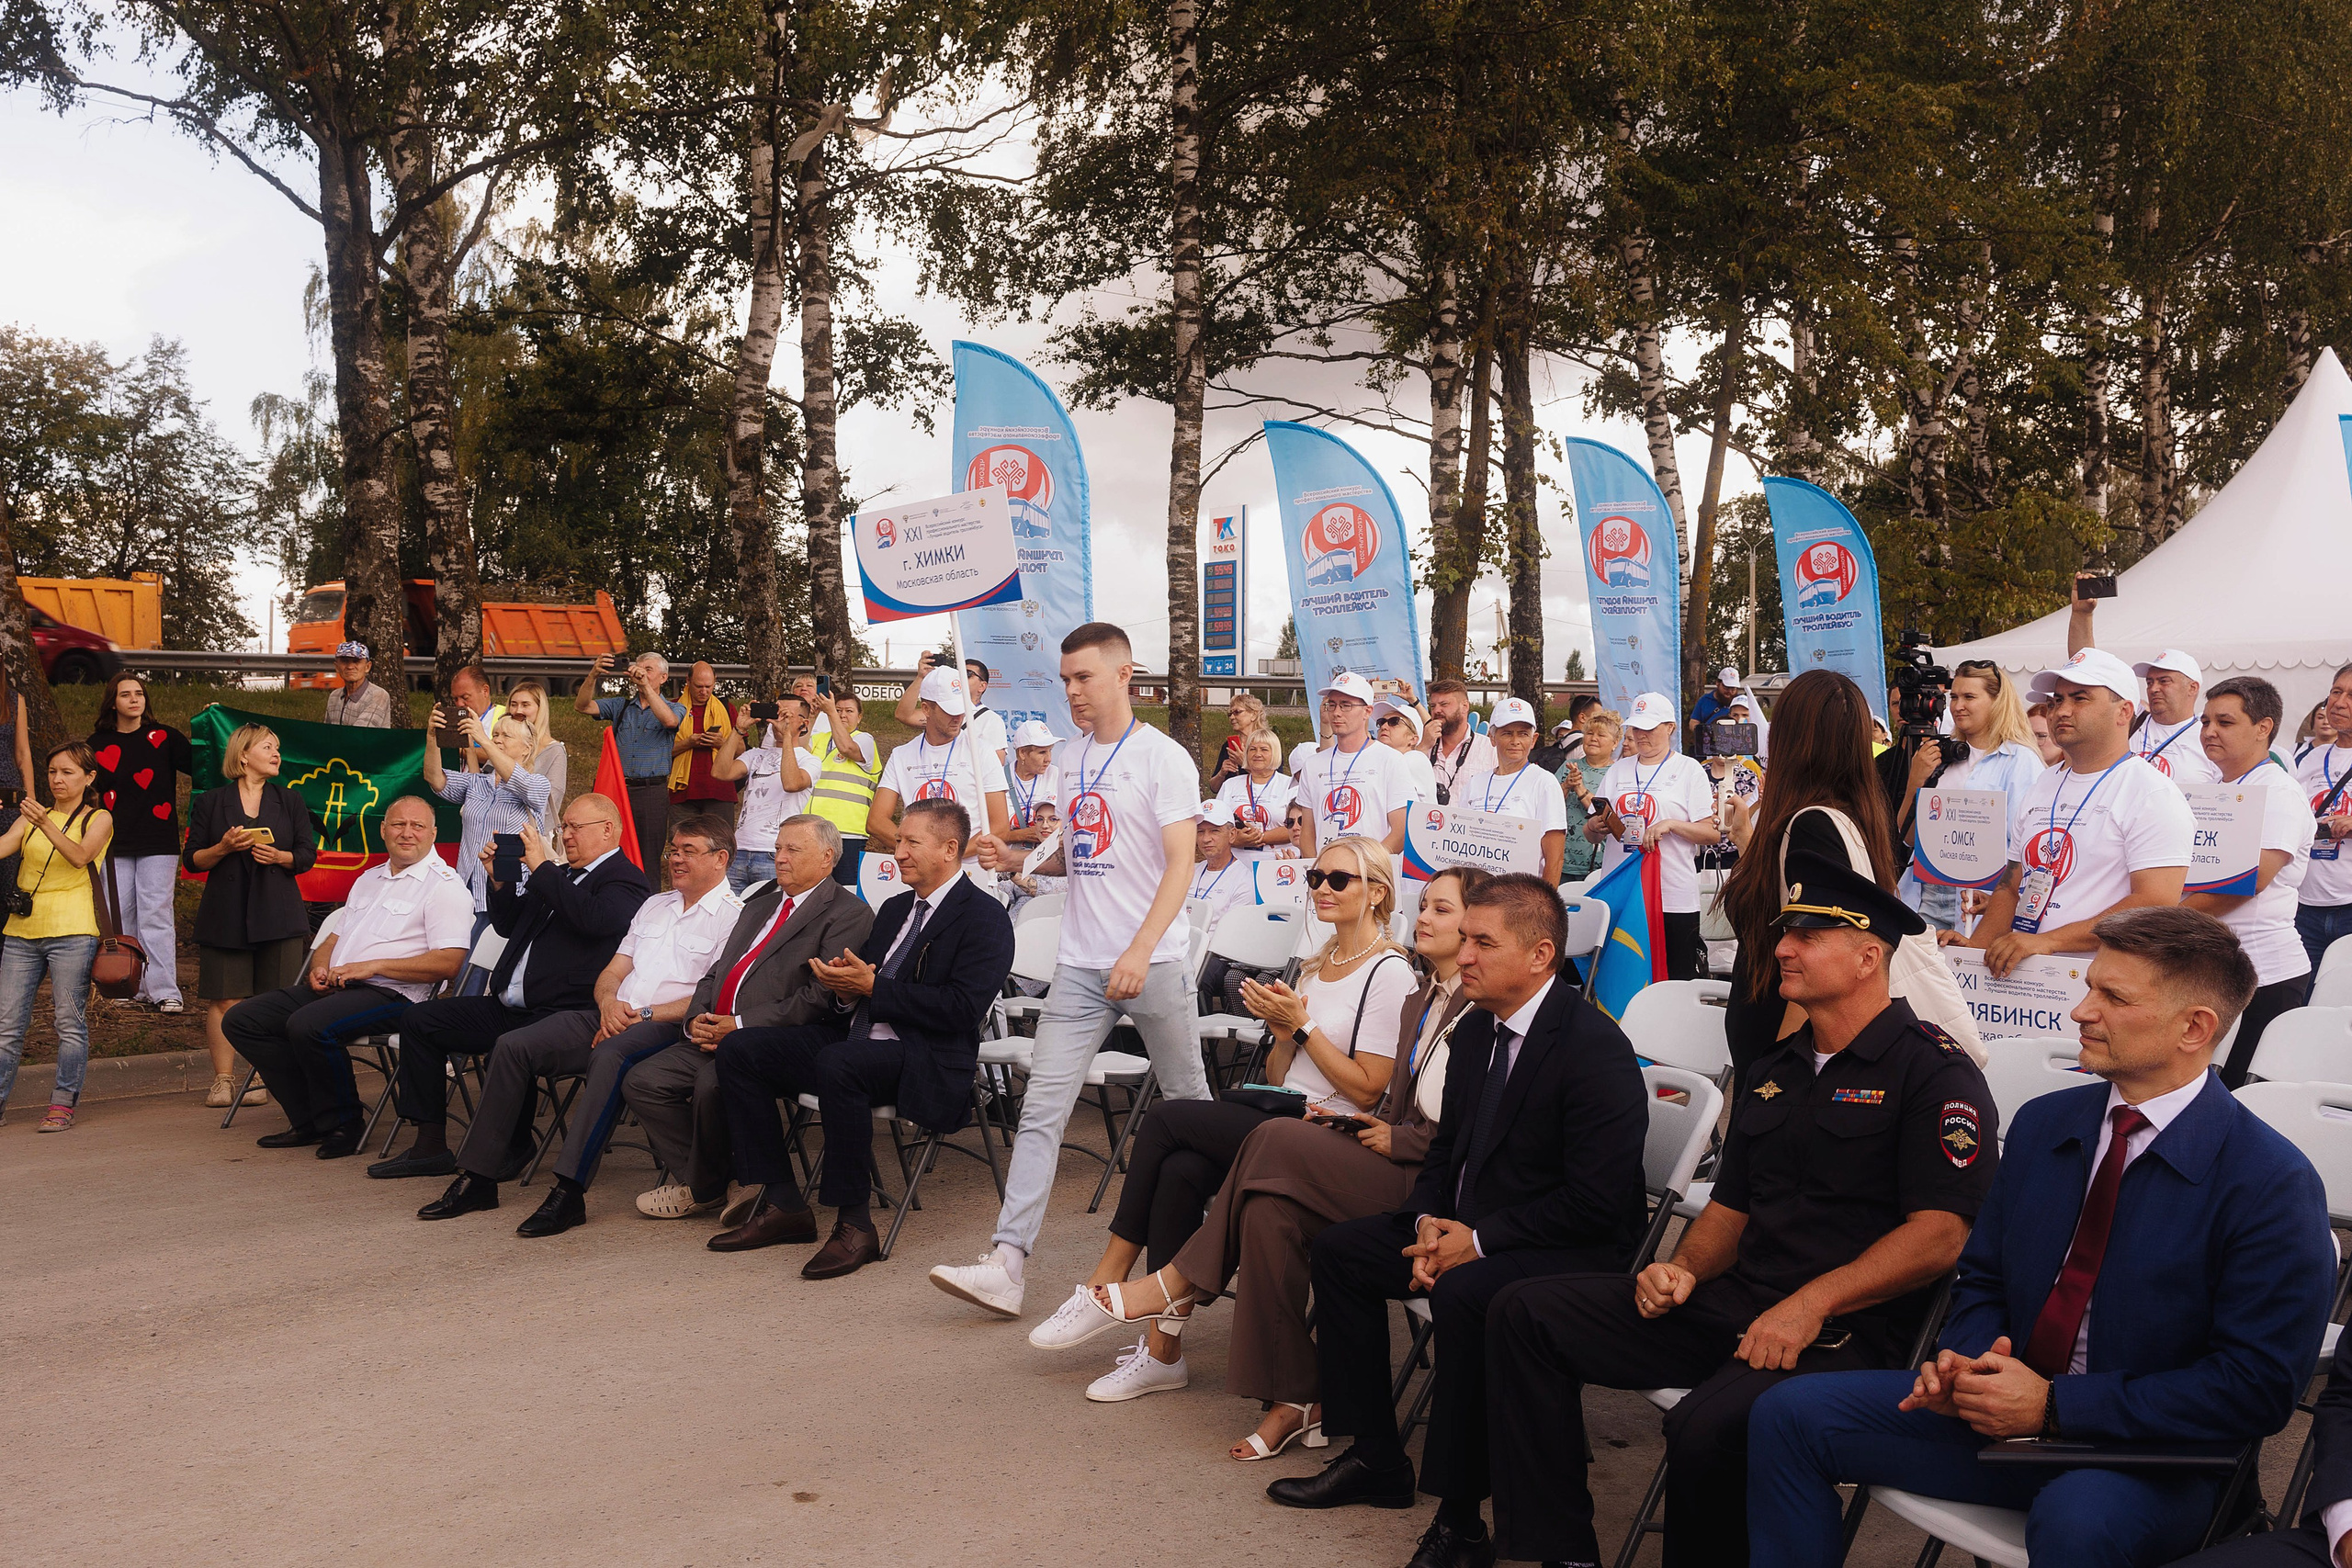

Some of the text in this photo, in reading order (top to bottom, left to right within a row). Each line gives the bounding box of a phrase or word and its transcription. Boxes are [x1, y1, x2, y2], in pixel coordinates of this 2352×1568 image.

[904, 526, 923, 543] XXI
[903, 544, 965, 571] г. ХИМКИ
[897, 568, 979, 590] Московская область
[1301, 589, 1389, 607] ЛУЧШИЙ ВОДИТЕЛЬ
[1312, 601, 1377, 616] ТРОЛЛЕЙБУСА
[1792, 611, 1862, 626] ЛУЧШИЙ ВОДИТЕЛЬ
[1945, 808, 1956, 821] XXI
[1450, 823, 1465, 835] XXI
[1943, 830, 1975, 847] г. ОМСК
[2194, 830, 2218, 847] ЕЖ
[1431, 839, 1510, 862] г. ПОДОЛЬСК
[1939, 849, 1978, 863] Омская область
[2191, 852, 2221, 863] бласть
[1478, 862, 1507, 874] область
[1984, 976, 2022, 985] Всероссийский
[1984, 982, 2035, 992] профессионального
[1966, 1001, 2062, 1032] ЛЯБИНСК
[1944, 1102, 1977, 1117] ПОЛИЦИЯ
[1944, 1116, 1976, 1132] РОССИЯ
[1952, 1156, 1967, 1168] МВД
